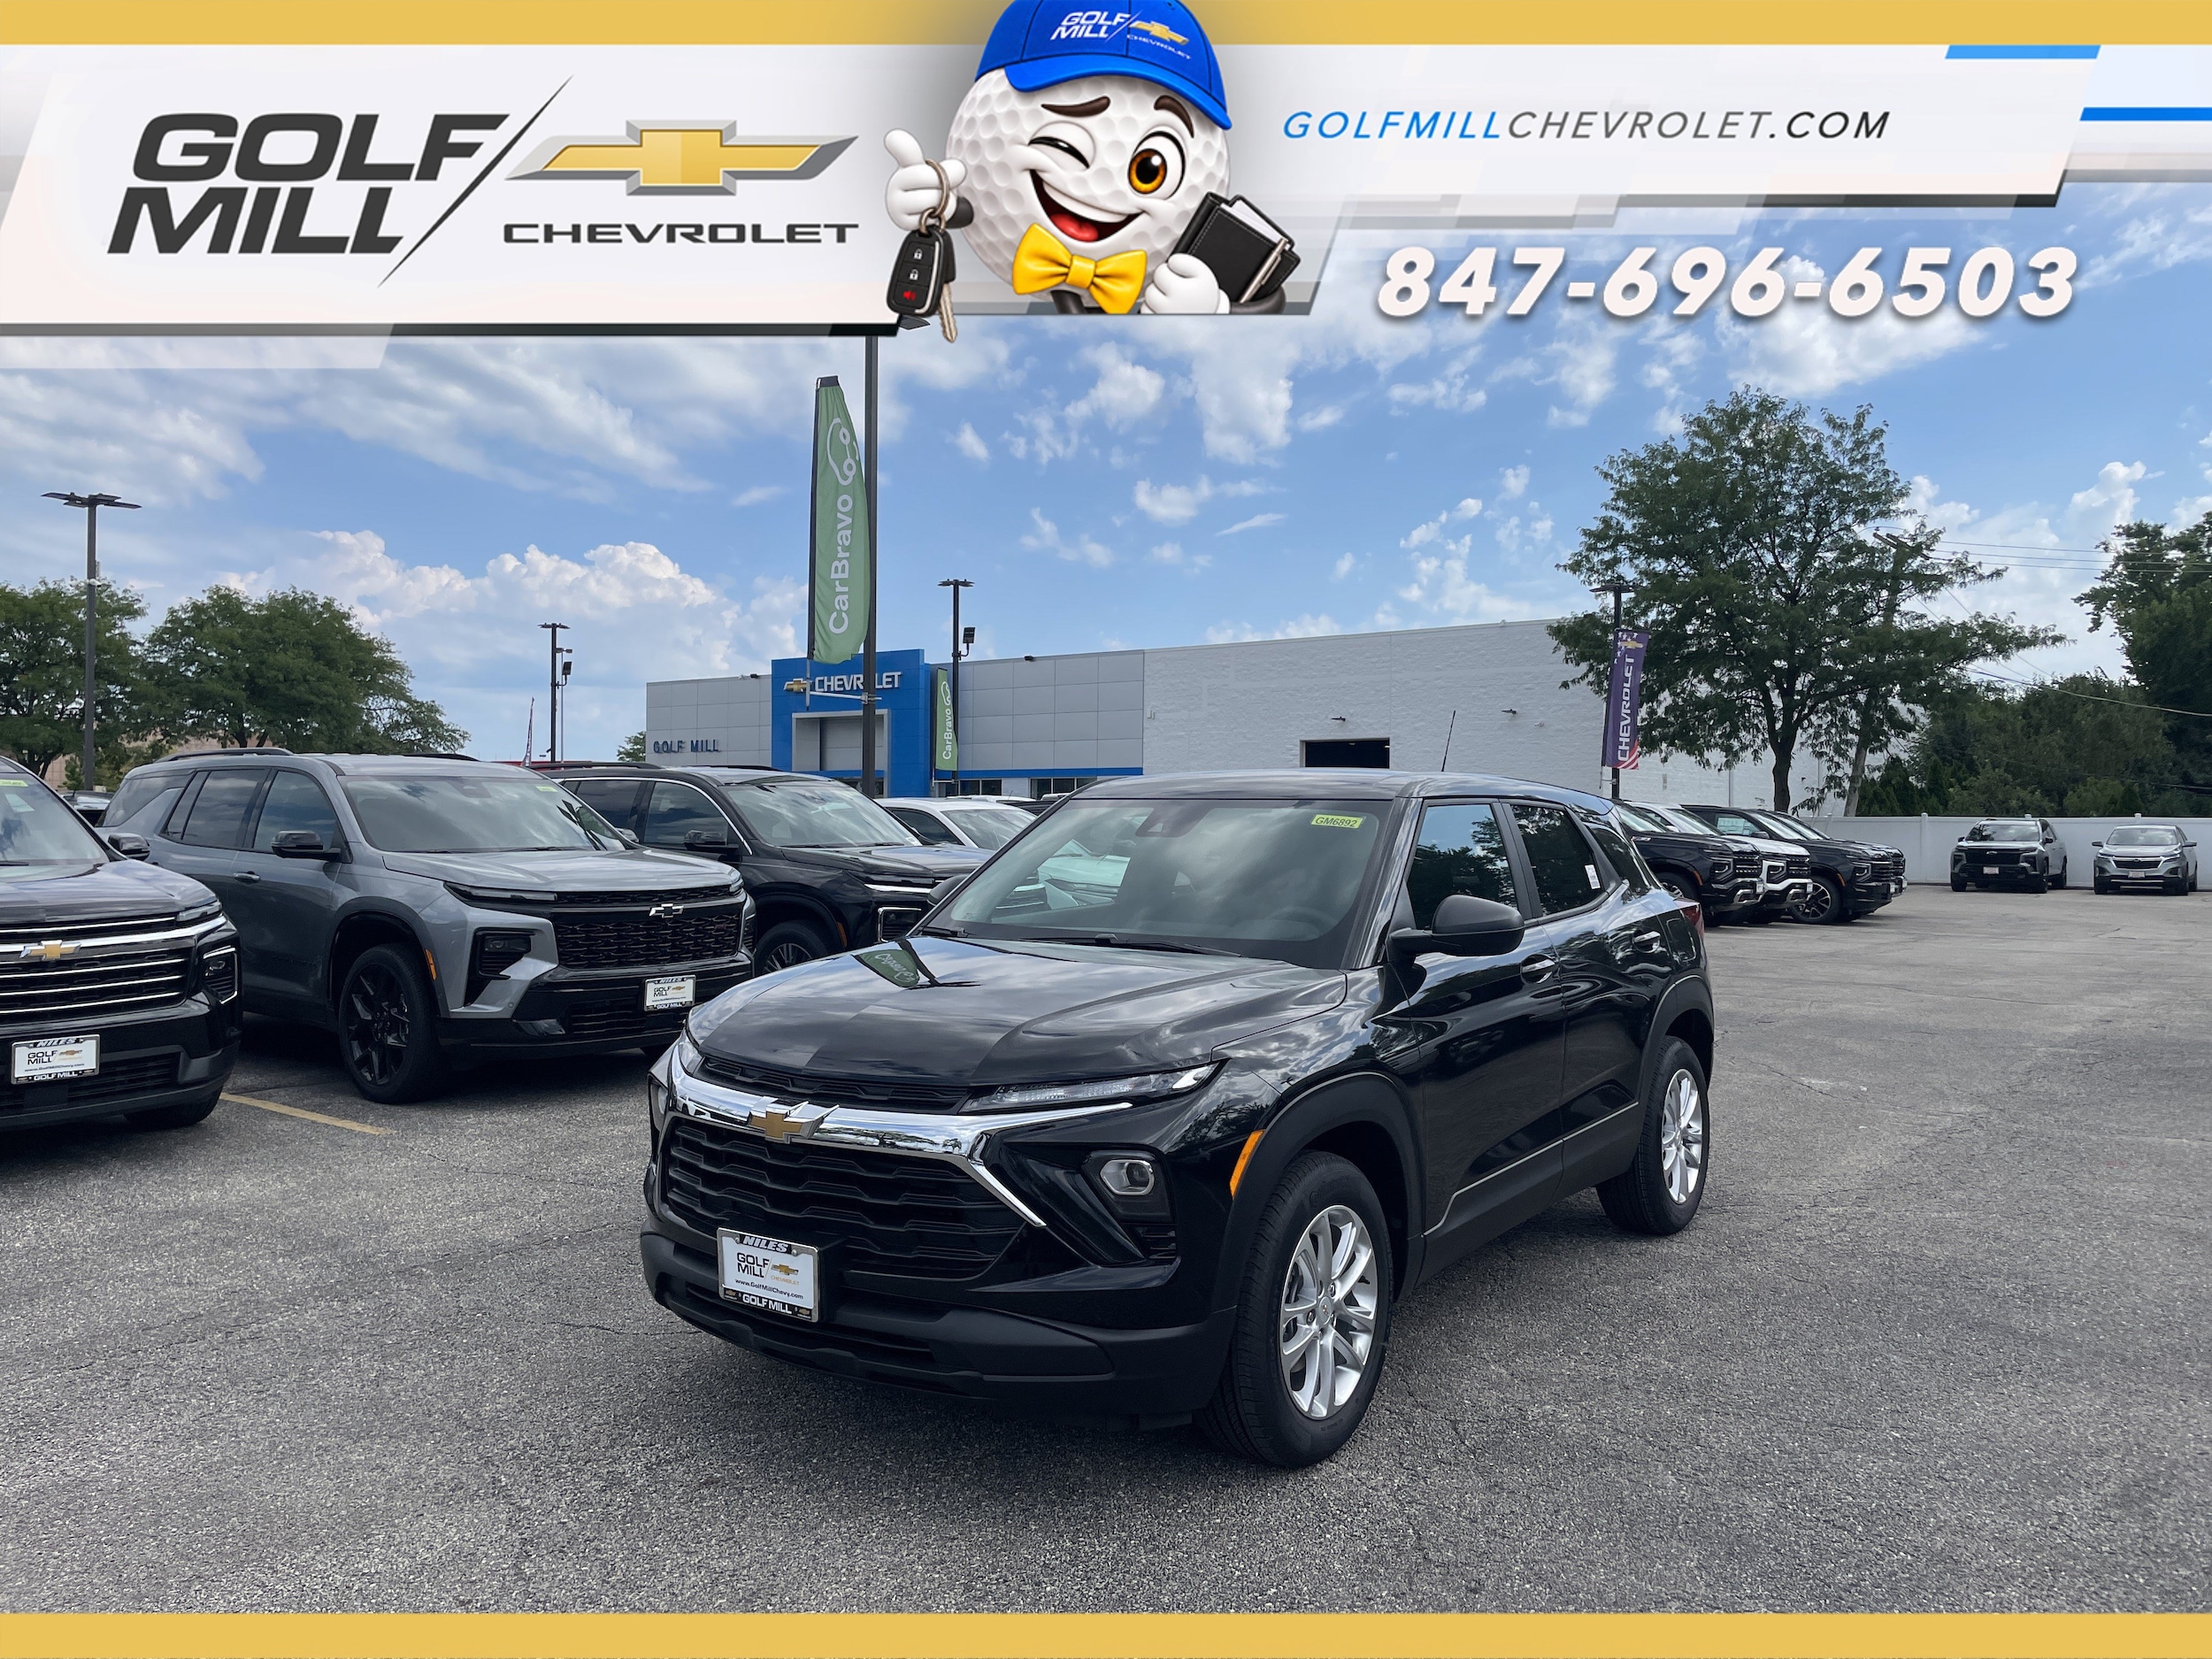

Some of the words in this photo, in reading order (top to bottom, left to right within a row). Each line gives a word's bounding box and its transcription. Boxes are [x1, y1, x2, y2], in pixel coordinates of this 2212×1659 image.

[828, 494, 854, 634] CarBravo
[814, 671, 902, 693] CHEVRLET
[1617, 654, 1635, 762] CHEVROLET
[942, 709, 953, 760] CarBravo
[653, 740, 685, 753] GOLF
[690, 739, 720, 752] MILL
[1315, 817, 1357, 827] GM6892
[36, 1038, 77, 1048] NILES
[27, 1050, 58, 1059] GOLF
[34, 1072, 58, 1081] GOLF
[742, 1235, 789, 1253] NILES
[736, 1252, 770, 1268] GOLF
[737, 1263, 764, 1279] MILL
[735, 1279, 804, 1300] www.GolfMillChevy.com
[742, 1294, 768, 1308] GOLF
[768, 1299, 793, 1314] MILL
